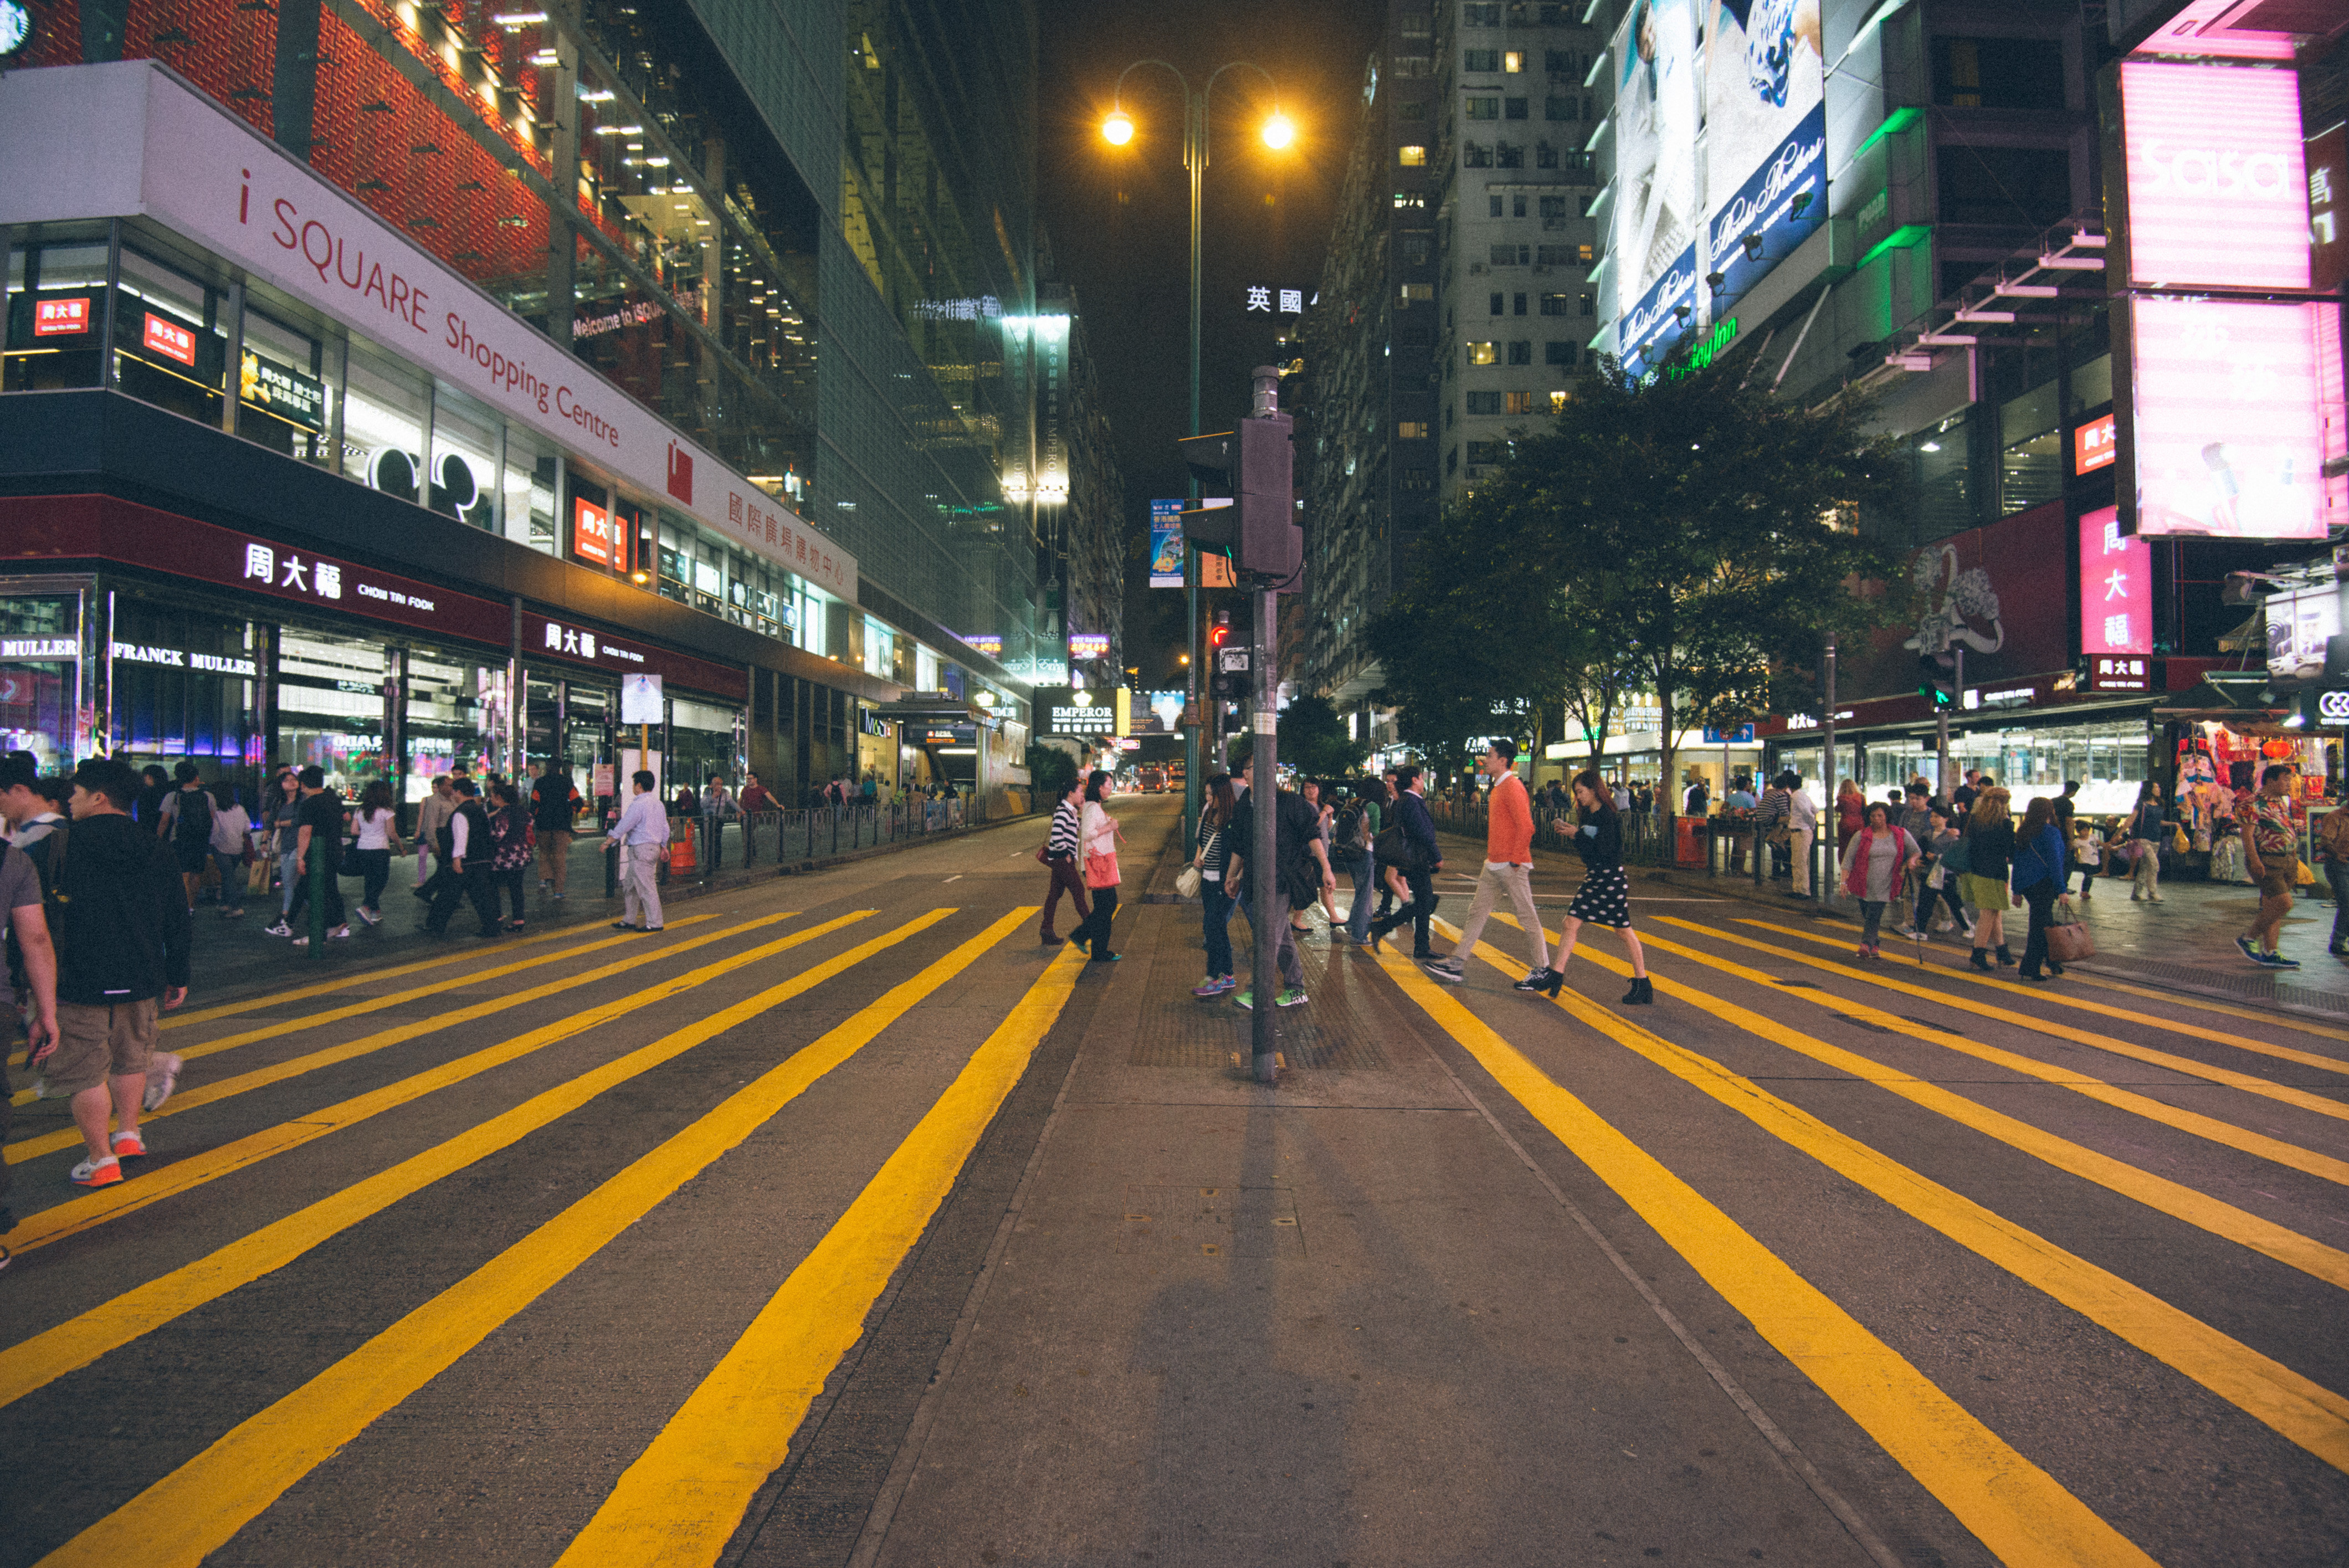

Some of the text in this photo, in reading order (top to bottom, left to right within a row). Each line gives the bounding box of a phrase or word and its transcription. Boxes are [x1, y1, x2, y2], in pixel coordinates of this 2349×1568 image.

[240, 168, 618, 447] i SQUARE Shopping Centre
[1247, 285, 1319, 314] 英國
[573, 314, 621, 337] Welcome
[620, 309, 632, 326] to
[1713, 317, 1736, 353] Inn
[729, 491, 844, 586] 國際廣場購物中心
[244, 542, 341, 599] 周大福
[357, 583, 435, 612] CHOW TAI FOOK
[1, 639, 79, 657] MULLER
[545, 623, 596, 658] 周大福
[602, 645, 644, 663] CHOW TAI FOOK
[112, 642, 257, 675] FRANCK MULLER
[2099, 659, 2145, 675] 周大福
[1052, 707, 1113, 718] EMPEROR
